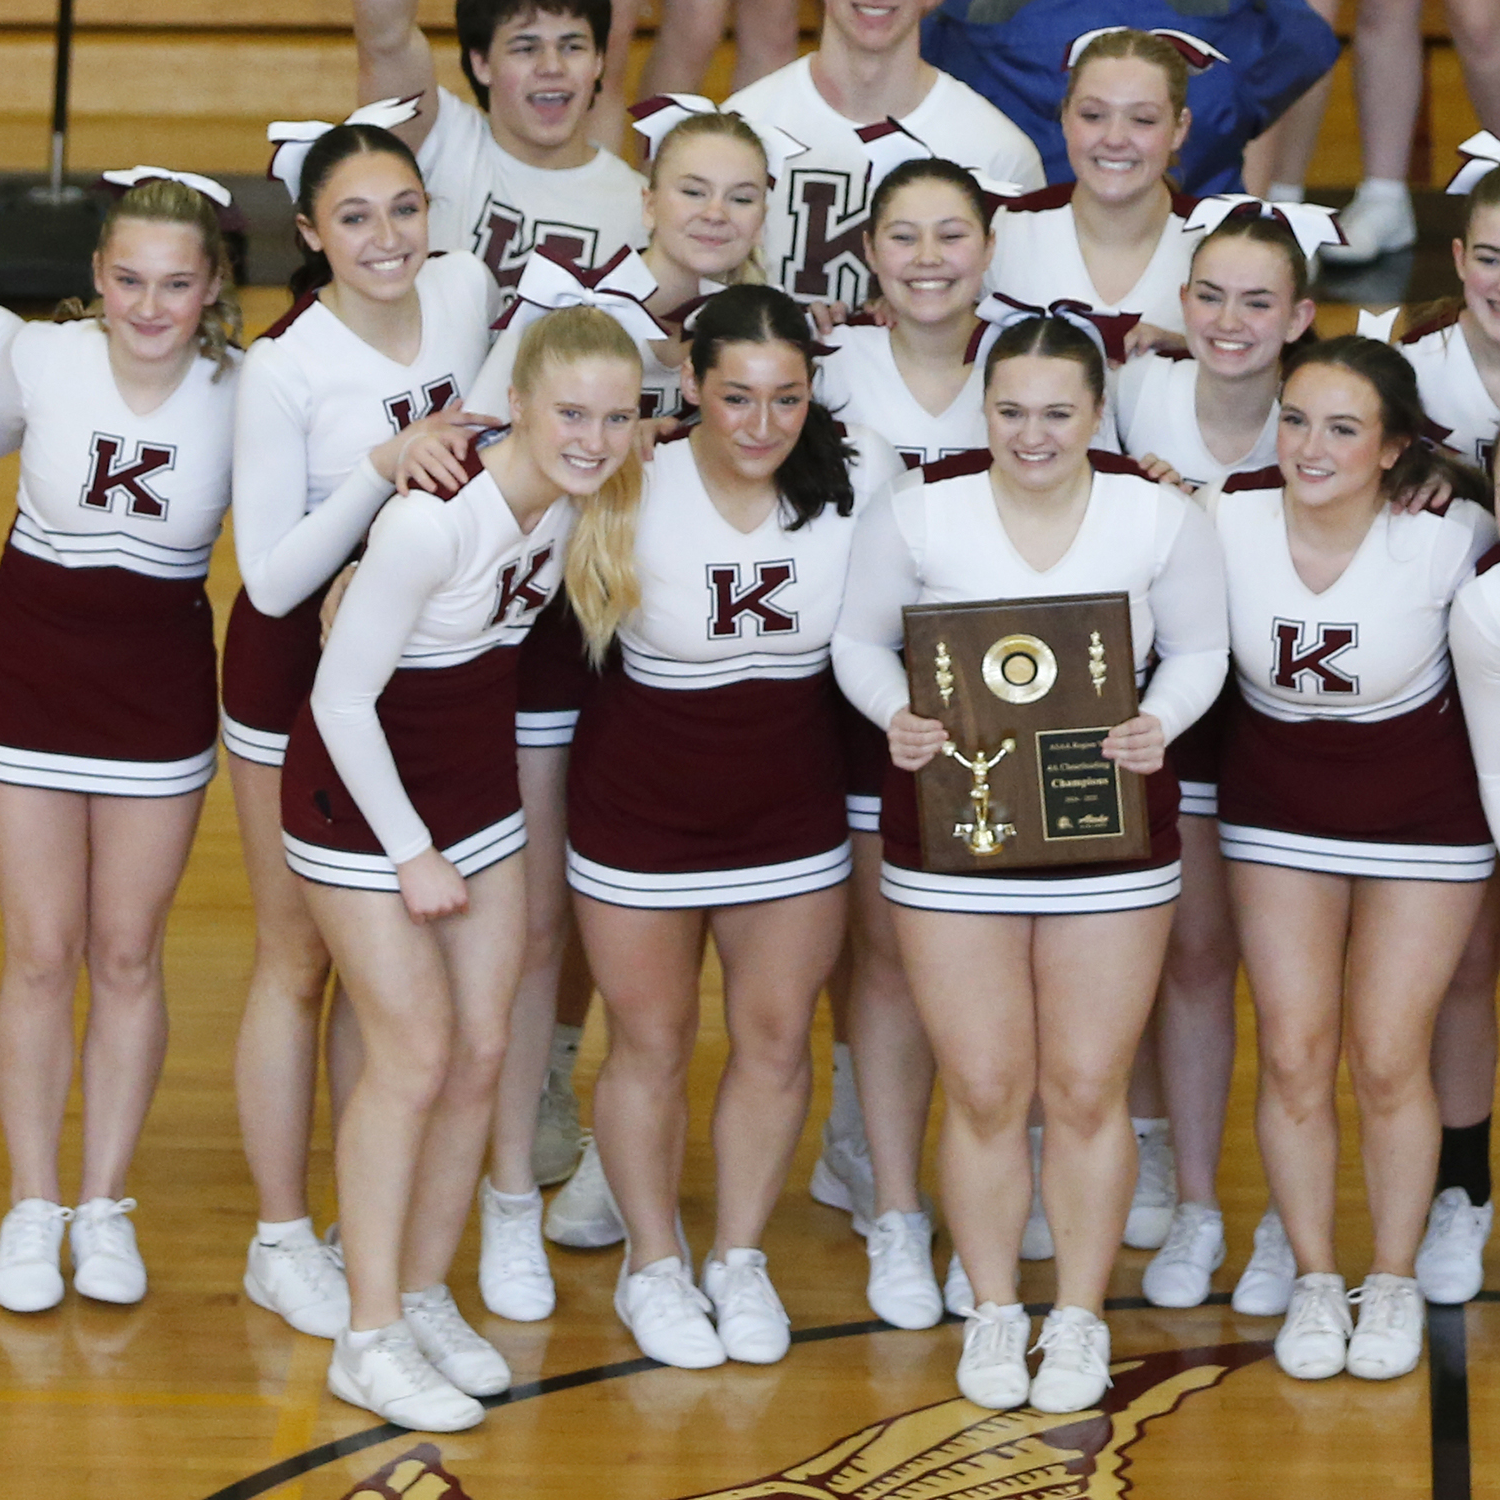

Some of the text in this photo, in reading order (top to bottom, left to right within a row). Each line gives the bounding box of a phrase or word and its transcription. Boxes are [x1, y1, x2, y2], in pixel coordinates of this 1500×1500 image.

[79, 430, 178, 522] K
[482, 539, 556, 631] K
[705, 558, 799, 641] K
[1271, 617, 1359, 696] K
[1050, 776, 1110, 789] Champions
